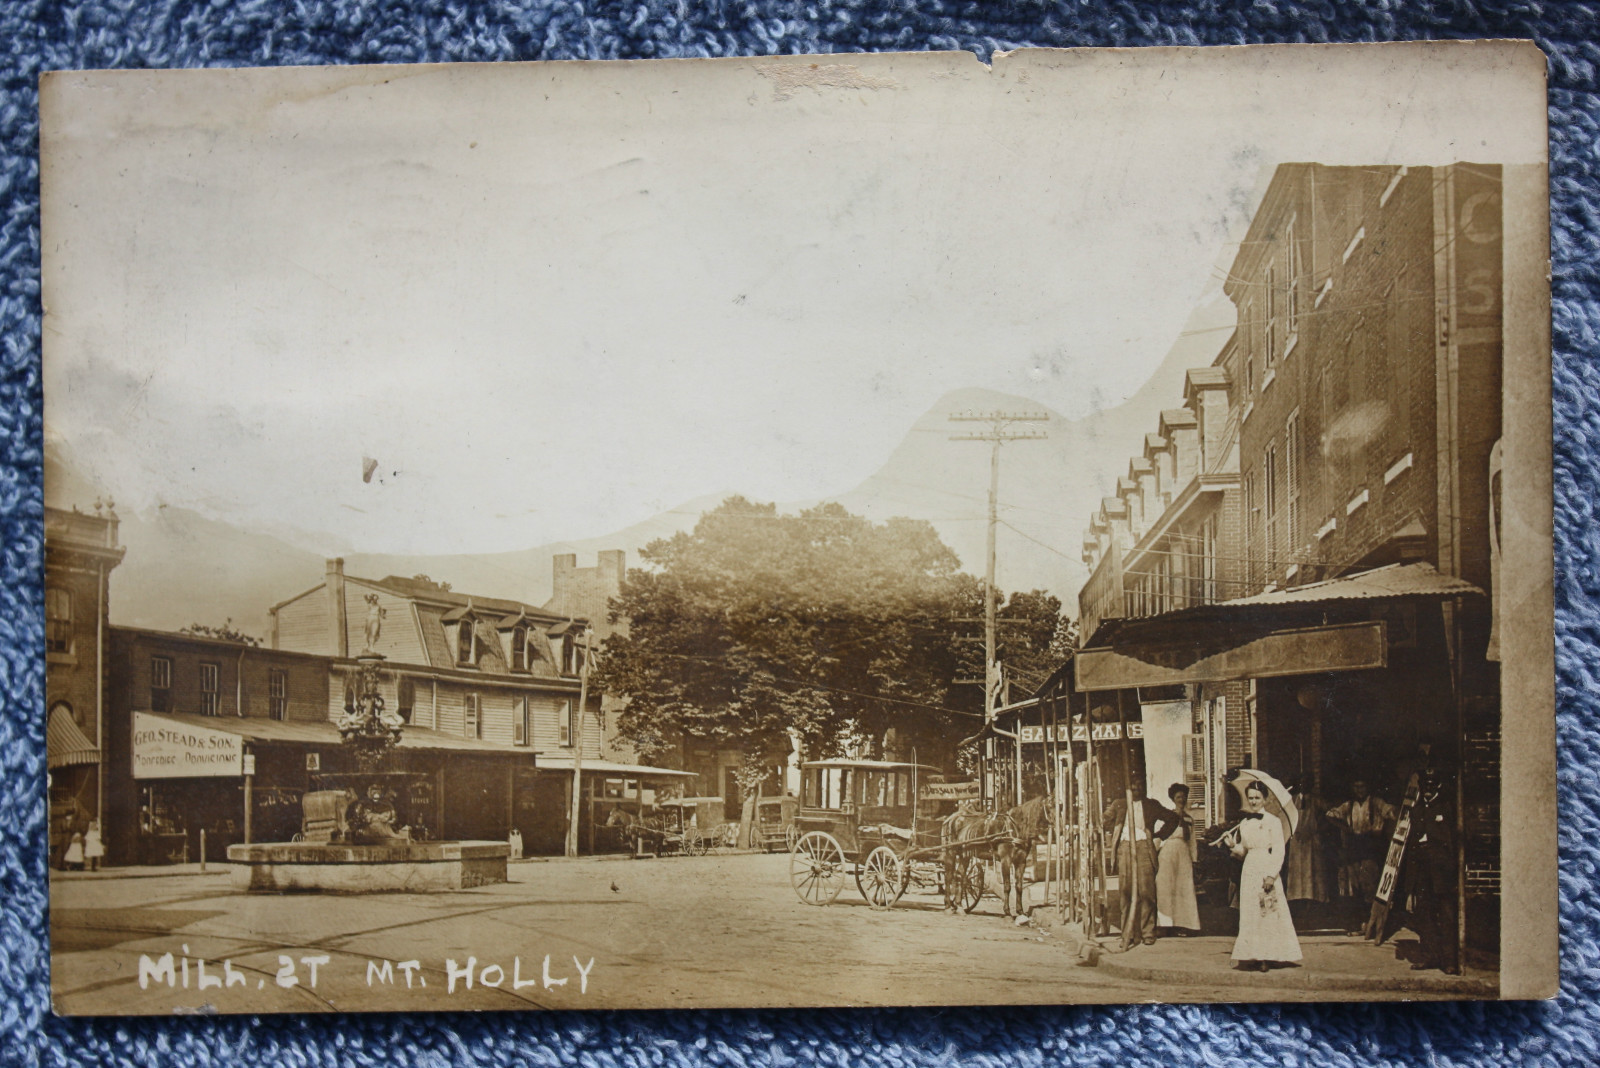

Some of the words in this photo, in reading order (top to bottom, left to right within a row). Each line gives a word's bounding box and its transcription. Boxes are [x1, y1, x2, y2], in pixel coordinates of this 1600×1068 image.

[158, 728, 197, 749] STEAD
[197, 739, 206, 749] &
[276, 954, 330, 988] ST
[446, 954, 595, 995] HOLLY
